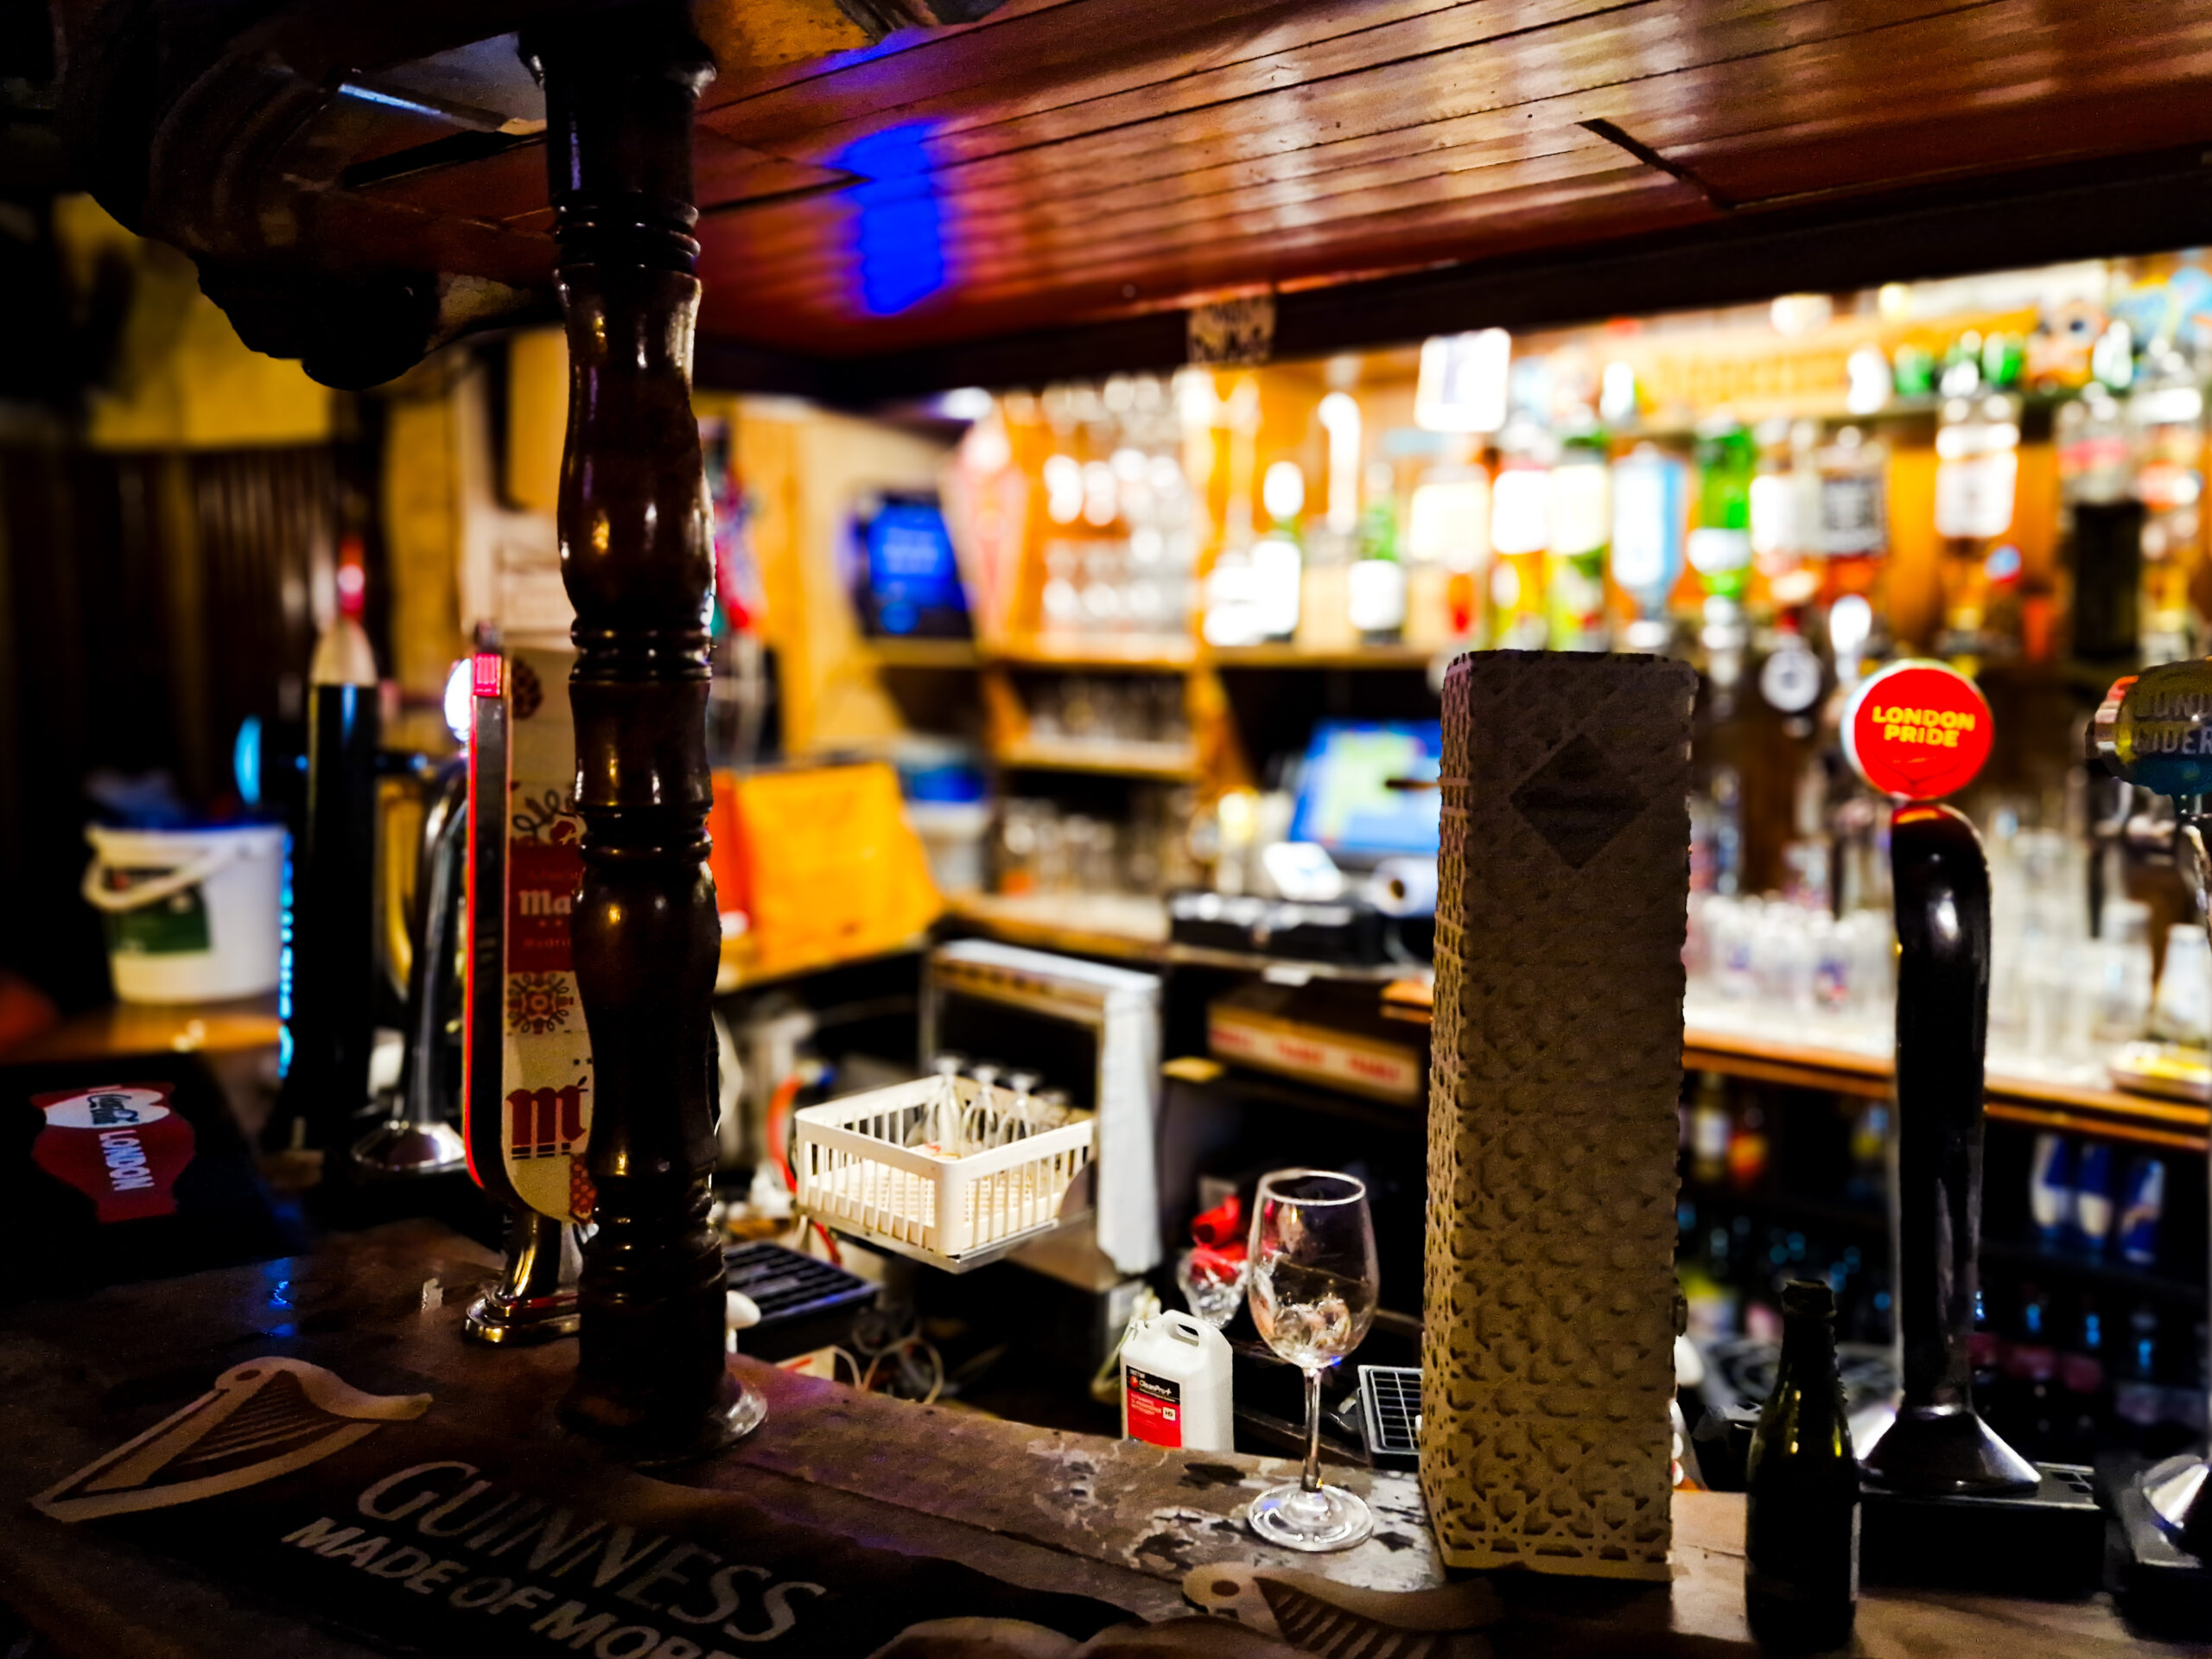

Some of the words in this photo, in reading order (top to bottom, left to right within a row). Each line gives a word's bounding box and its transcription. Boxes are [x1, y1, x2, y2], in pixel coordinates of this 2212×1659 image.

[1872, 704, 1976, 732] LONDON
[1883, 723, 1961, 748] PRIDE
[518, 888, 572, 917] Ma
[99, 1129, 156, 1192] LONDON
[280, 1516, 470, 1595] MADE
[448, 1576, 556, 1616] OF
[357, 1459, 827, 1642] GUINNESS
